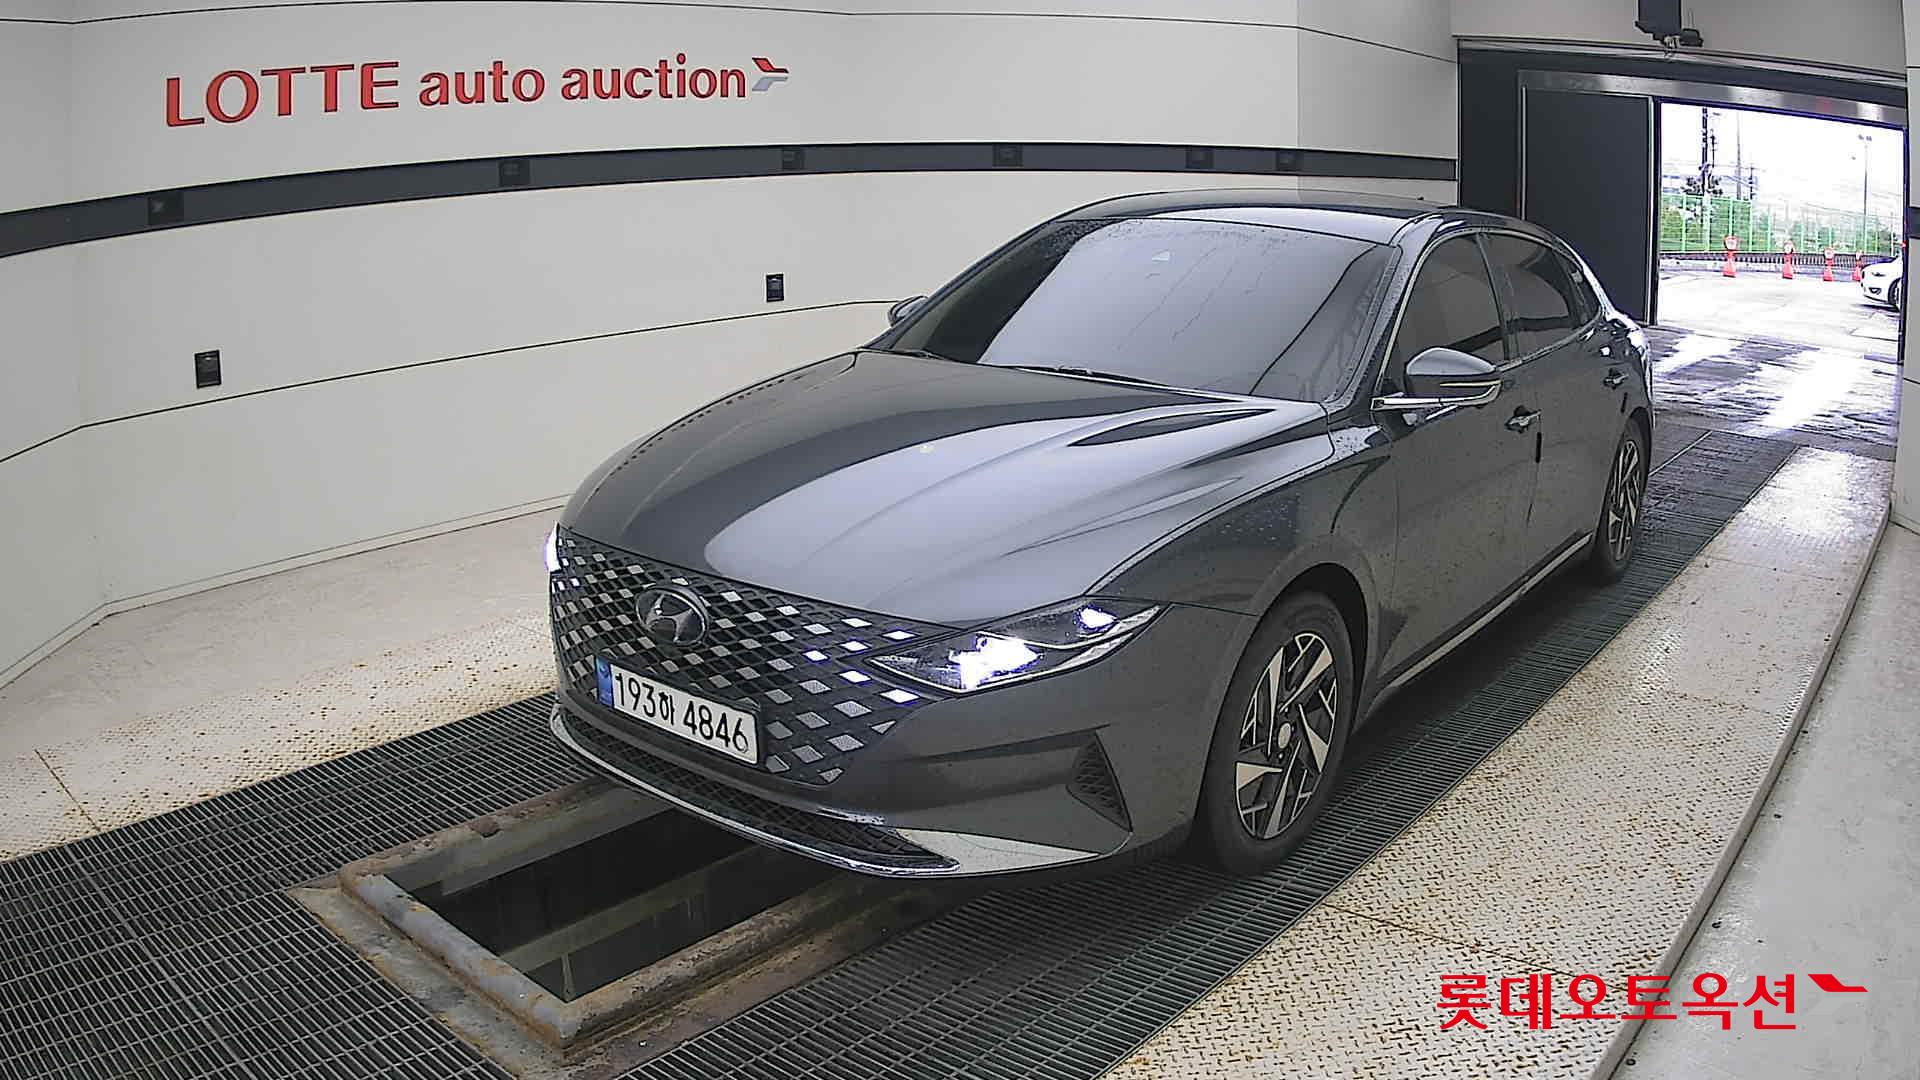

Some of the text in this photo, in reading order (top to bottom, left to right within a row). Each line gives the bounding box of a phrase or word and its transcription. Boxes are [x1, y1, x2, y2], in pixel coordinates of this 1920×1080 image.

[166, 52, 747, 127] LOTTE auto auction
[614, 672, 750, 753] 193하 4846
